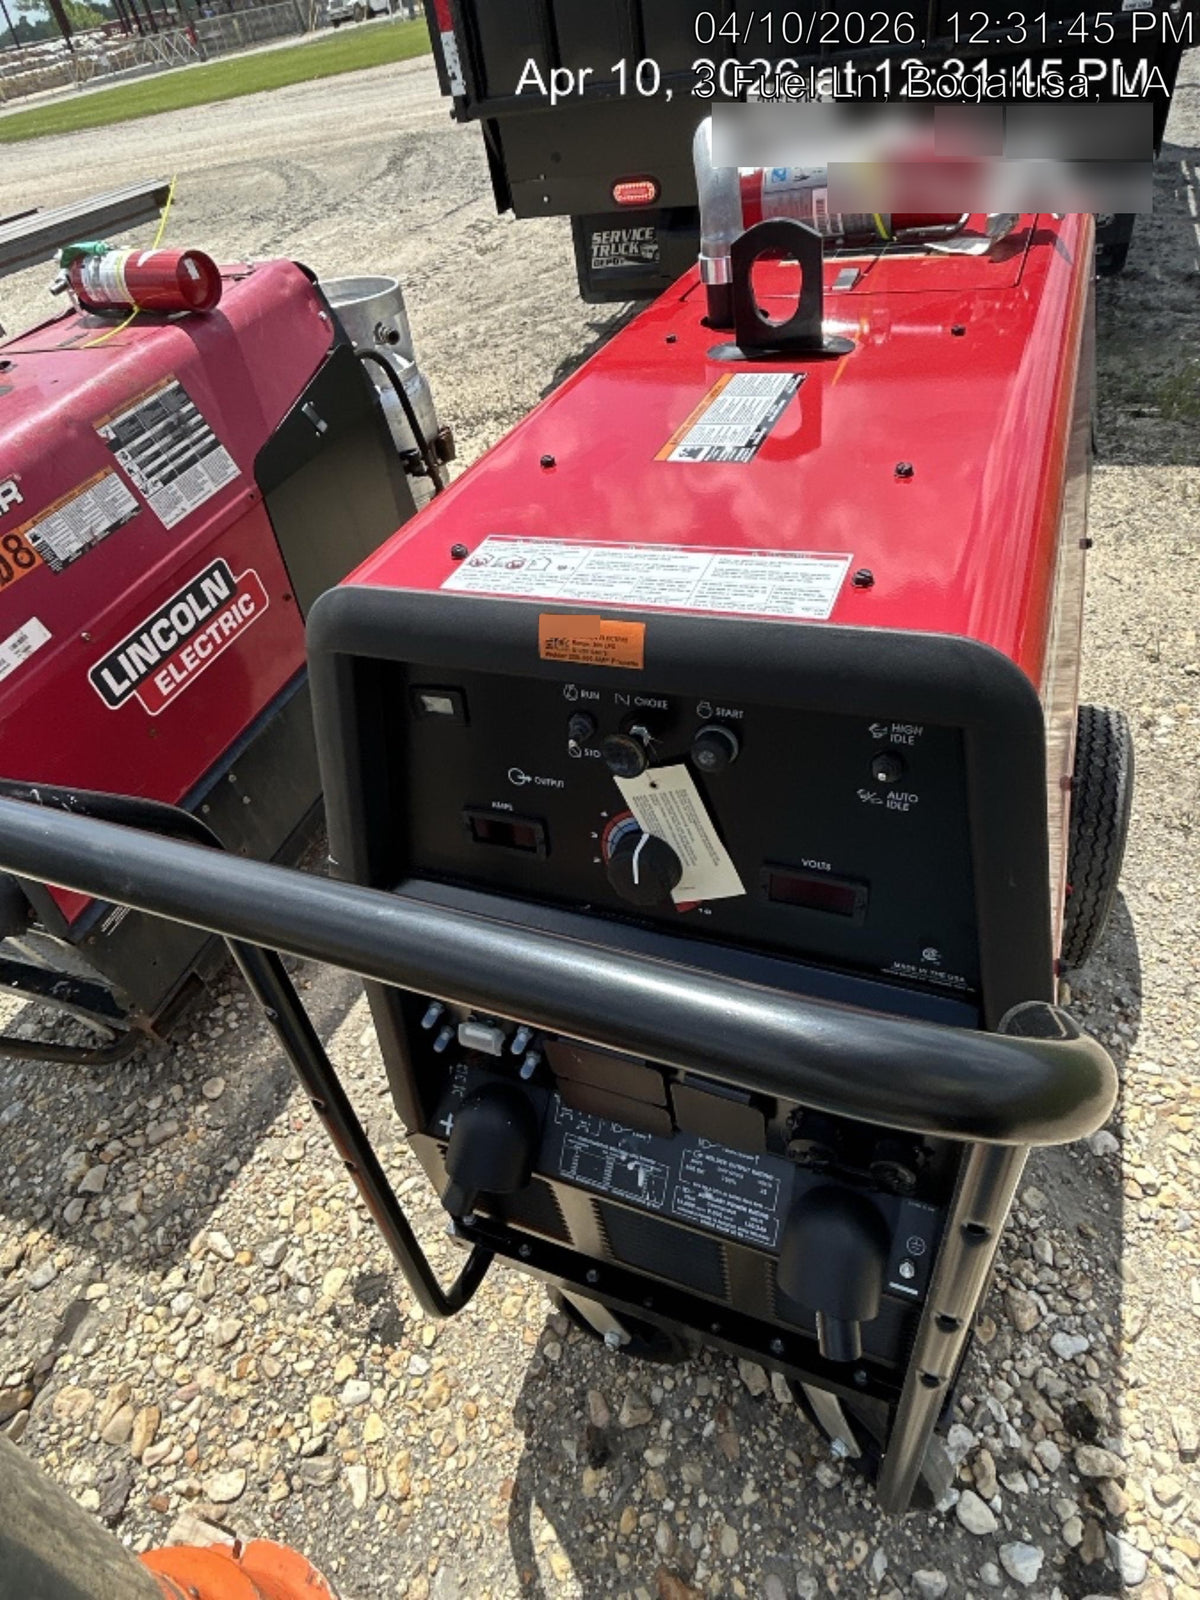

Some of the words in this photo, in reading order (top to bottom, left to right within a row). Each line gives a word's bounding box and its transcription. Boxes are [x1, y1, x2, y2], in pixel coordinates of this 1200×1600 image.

[592, 227, 655, 244] SERVICE
[592, 242, 639, 257] TRUCK
[100, 569, 231, 697] LINCOLN
[153, 593, 255, 696] ELECTRIC
[581, 689, 600, 700] RUN
[634, 696, 669, 710] CHOKE
[715, 707, 745, 719] START
[892, 722, 924, 737] HIGH
[890, 733, 915, 746] IDLE
[584, 747, 601, 759] STO
[887, 790, 919, 803] AUTO
[886, 800, 911, 811] IDLE
[801, 858, 832, 872] VOLTS
